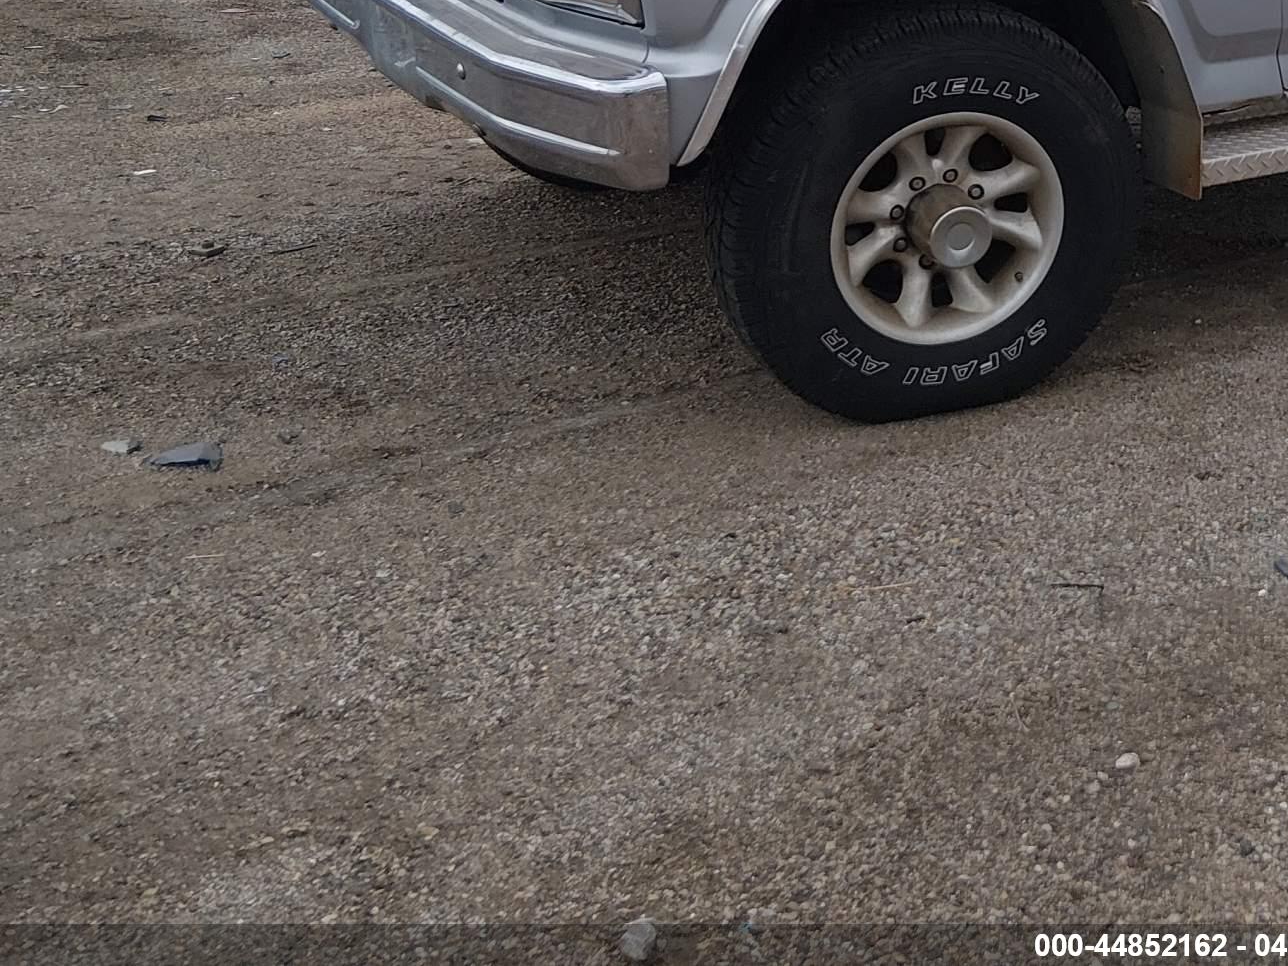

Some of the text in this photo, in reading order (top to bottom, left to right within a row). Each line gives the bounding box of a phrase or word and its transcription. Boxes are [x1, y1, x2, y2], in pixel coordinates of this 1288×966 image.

[912, 77, 1040, 105] KELLY
[820, 318, 1048, 385] SAFARI ATR
